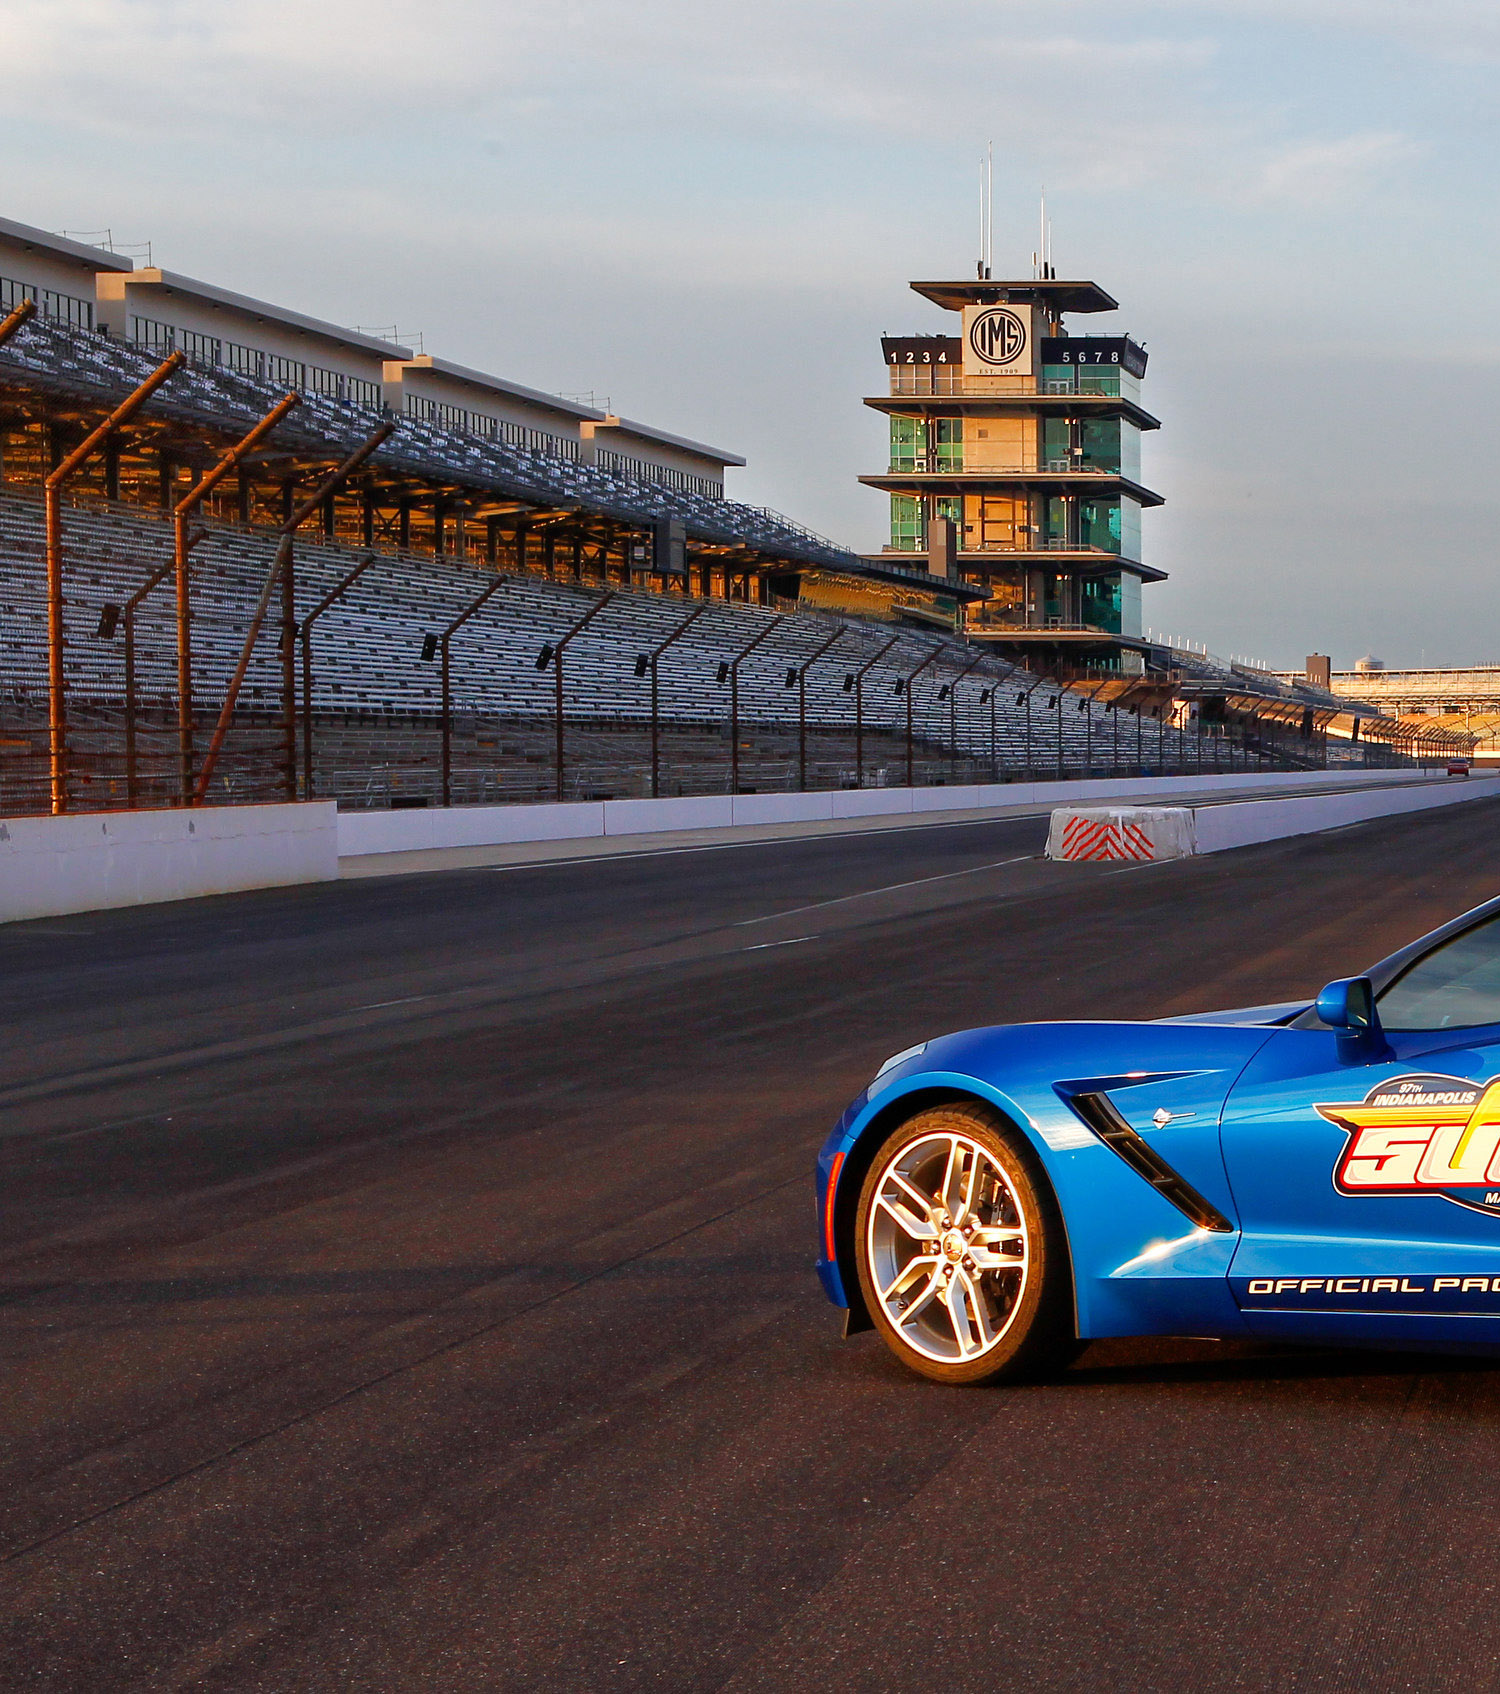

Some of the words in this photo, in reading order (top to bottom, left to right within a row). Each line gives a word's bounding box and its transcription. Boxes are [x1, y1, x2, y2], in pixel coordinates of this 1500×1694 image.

[979, 316, 1019, 358] IMS
[890, 351, 897, 364] 1
[906, 351, 915, 364] 2
[922, 351, 931, 364] 3
[938, 351, 947, 364] 4
[1062, 351, 1070, 363] 5
[1078, 351, 1086, 363] 6
[1094, 351, 1103, 363] 7
[1111, 351, 1119, 363] 8
[1398, 1083, 1424, 1094] 97TH
[1372, 1090, 1477, 1107] INDIANAPOLIS
[1247, 1278, 1426, 1294] OFFICIAL
